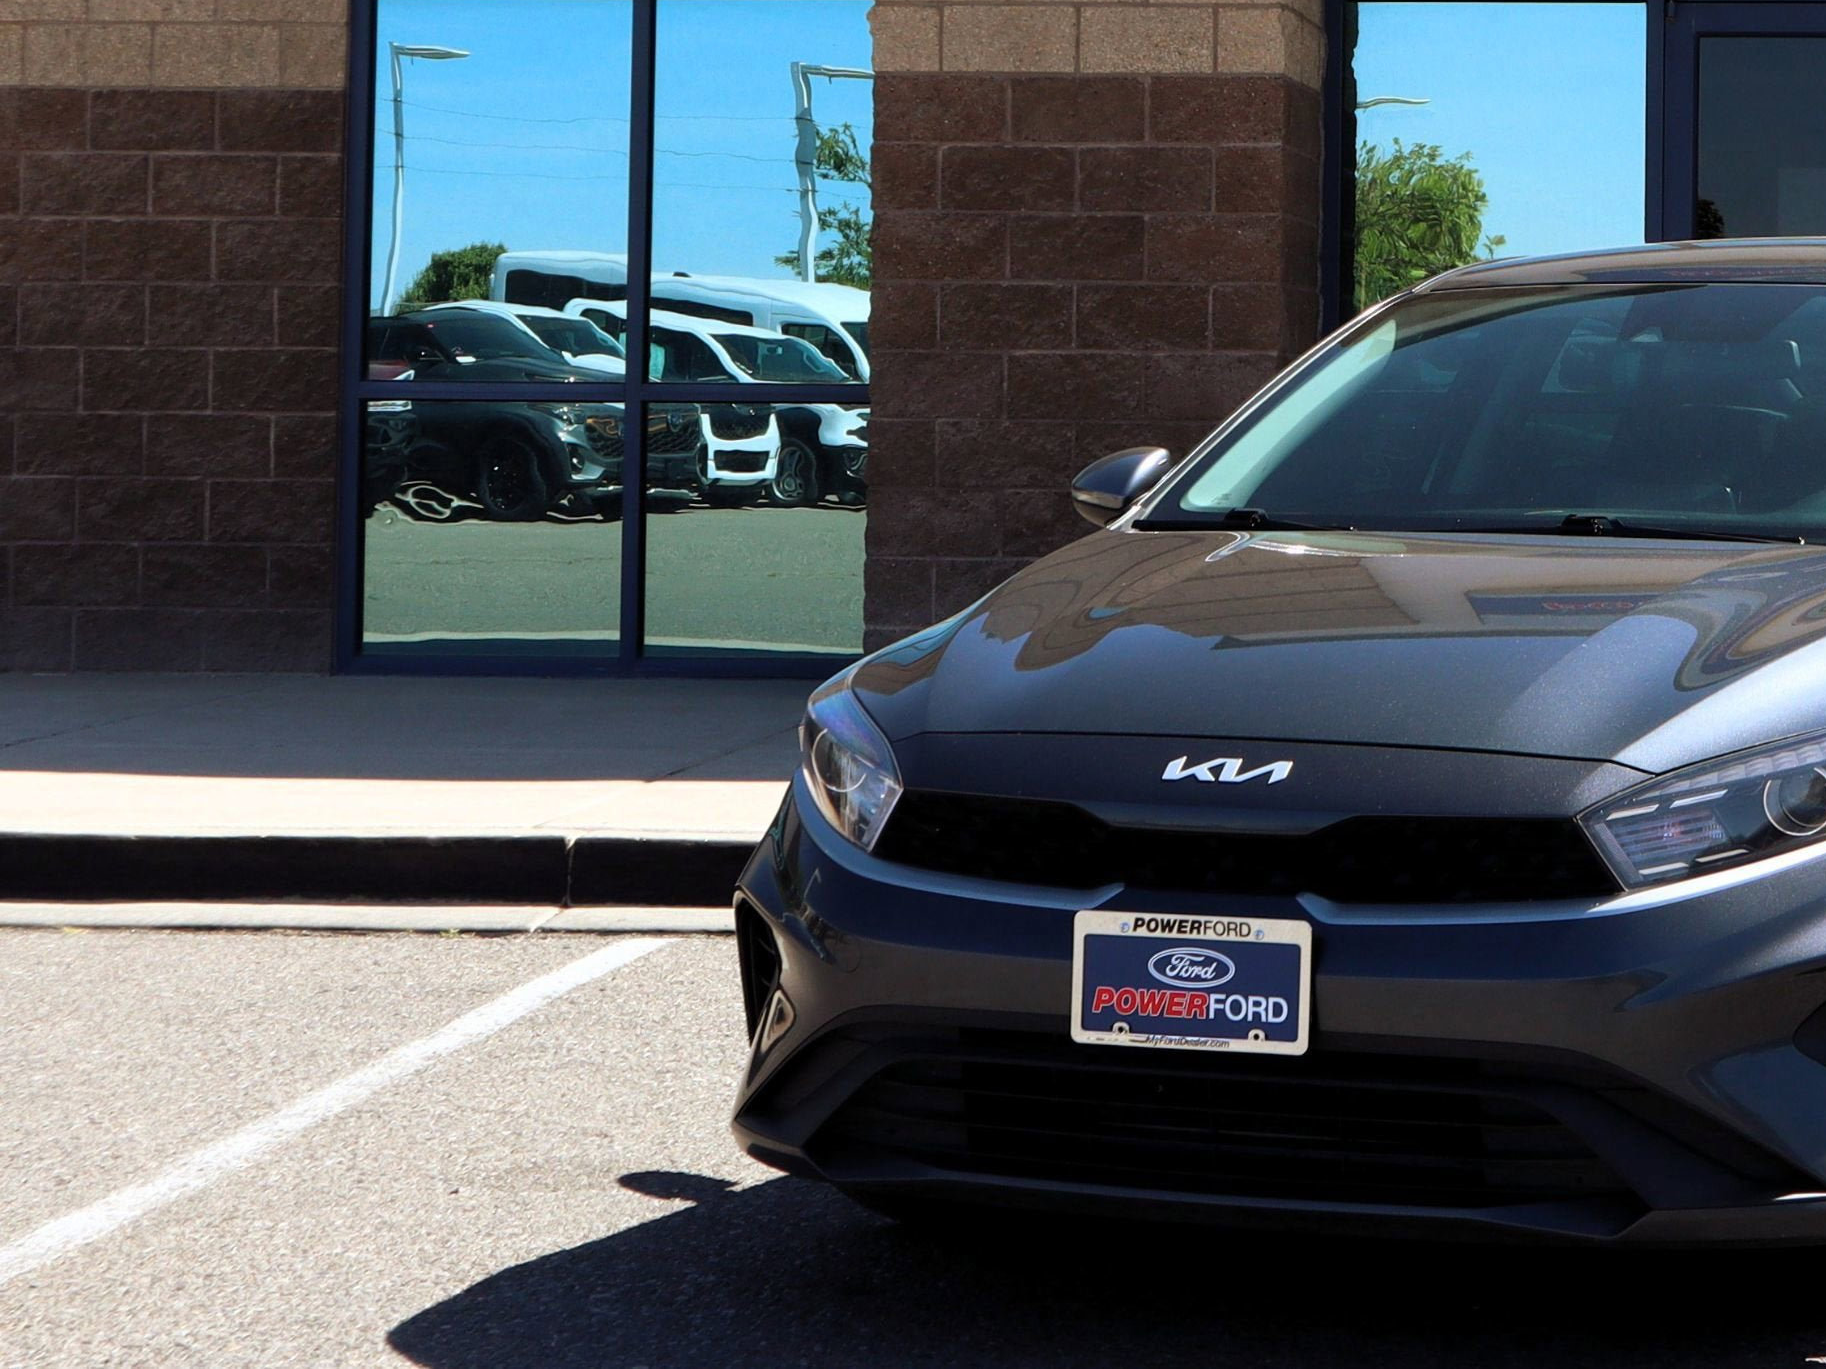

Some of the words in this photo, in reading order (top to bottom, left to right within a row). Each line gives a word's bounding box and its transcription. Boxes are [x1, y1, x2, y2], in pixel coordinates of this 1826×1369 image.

[1162, 755, 1293, 784] KIA
[1133, 917, 1251, 938] POWERFORD
[1165, 954, 1217, 979] Ford
[1092, 986, 1288, 1023] POWERFORD
